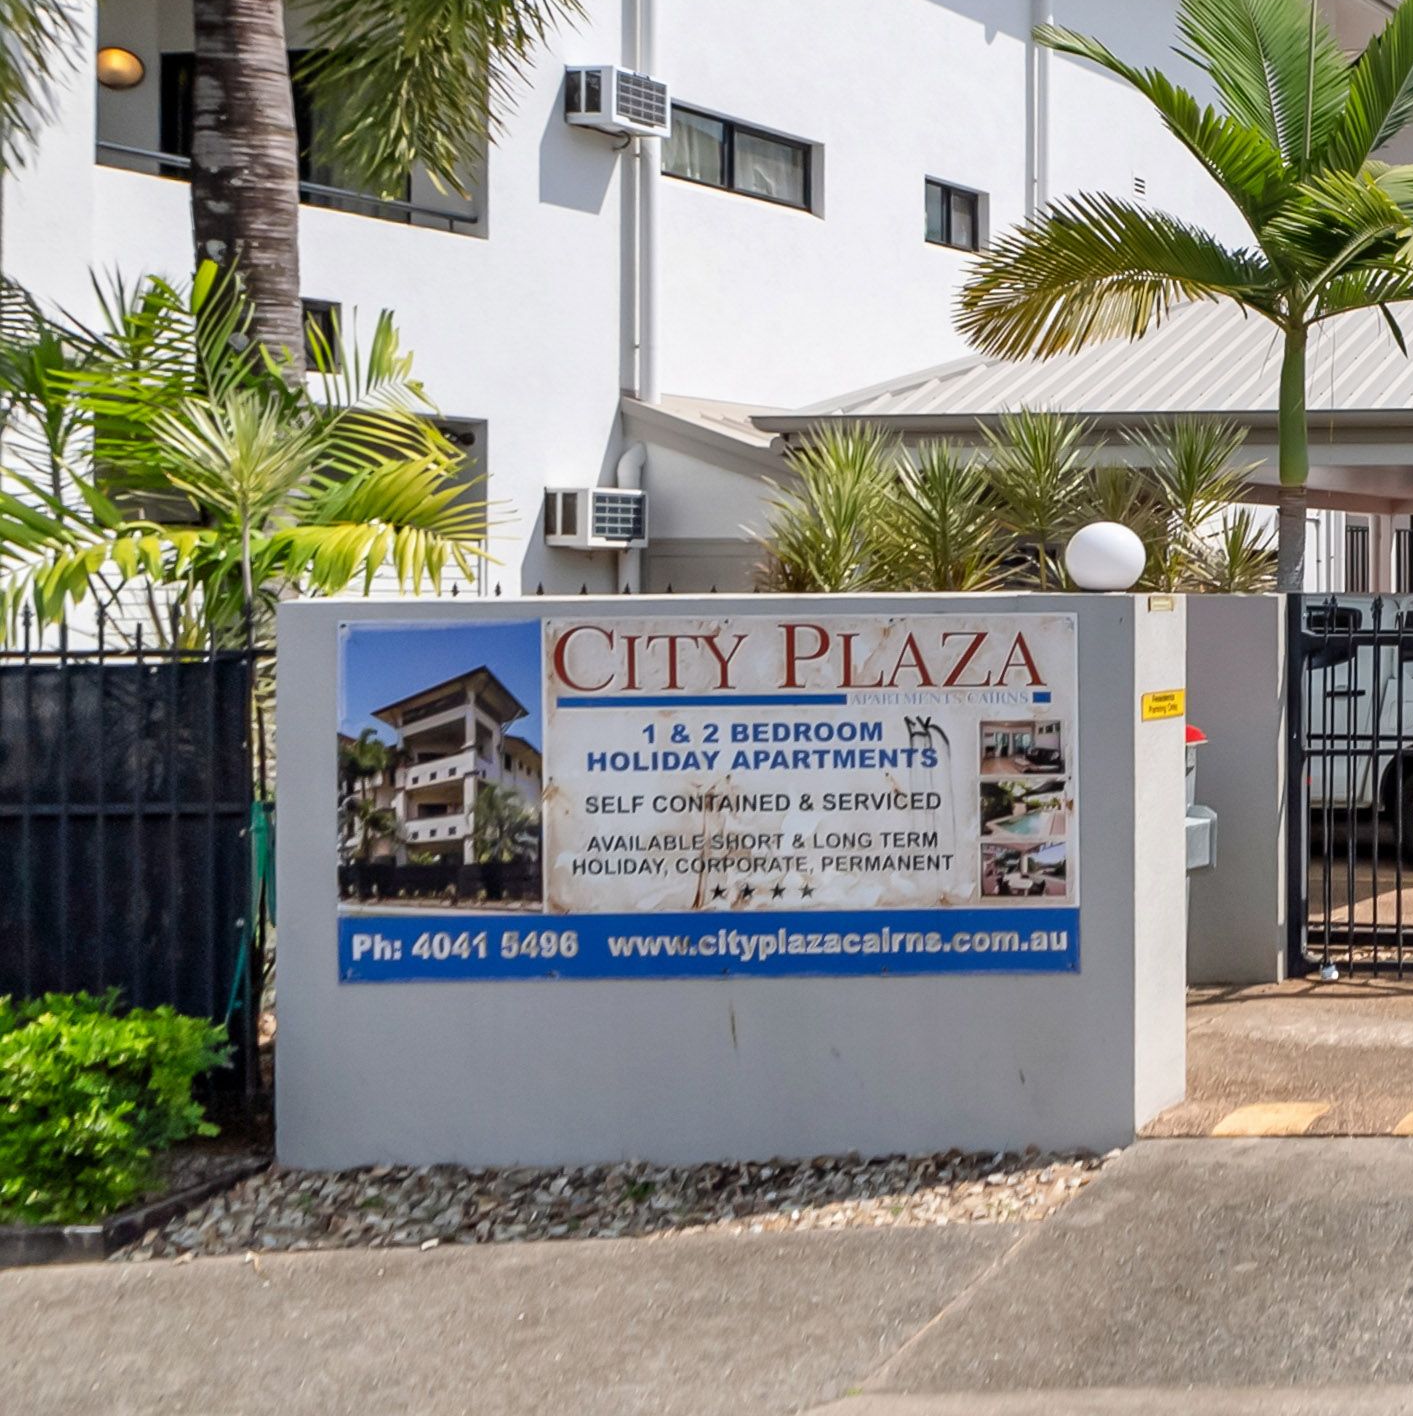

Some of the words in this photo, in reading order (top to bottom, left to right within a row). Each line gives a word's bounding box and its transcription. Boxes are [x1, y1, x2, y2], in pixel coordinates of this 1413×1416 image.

[553, 625, 749, 692] CITY
[777, 623, 1048, 689] PLAZA
[850, 691, 962, 706] APARTMENTS
[642, 723, 656, 744] 1
[670, 723, 691, 744] &
[702, 723, 720, 744] 2
[731, 721, 883, 743] BEDROOM
[587, 751, 721, 772] HOLIDAY
[731, 748, 939, 771] APARTMENTS
[585, 795, 645, 814] SELF
[652, 793, 791, 814] CONTAINED
[798, 793, 814, 812] &
[822, 792, 942, 811] SERVICED
[587, 835, 703, 852] AVAILABLE
[711, 833, 784, 851] SHORT
[792, 833, 804, 849] &
[813, 833, 873, 849] LONG
[880, 832, 939, 849] TERM
[572, 858, 669, 877] HOLIDAY,
[675, 855, 814, 874] CORPORATE,
[821, 854, 955, 872] PERMANENT
[352, 934, 402, 961] Ph:
[411, 931, 487, 960] 4041
[500, 930, 579, 959] 5496
[607, 926, 1069, 961] www.cityplazacairns.com.au
